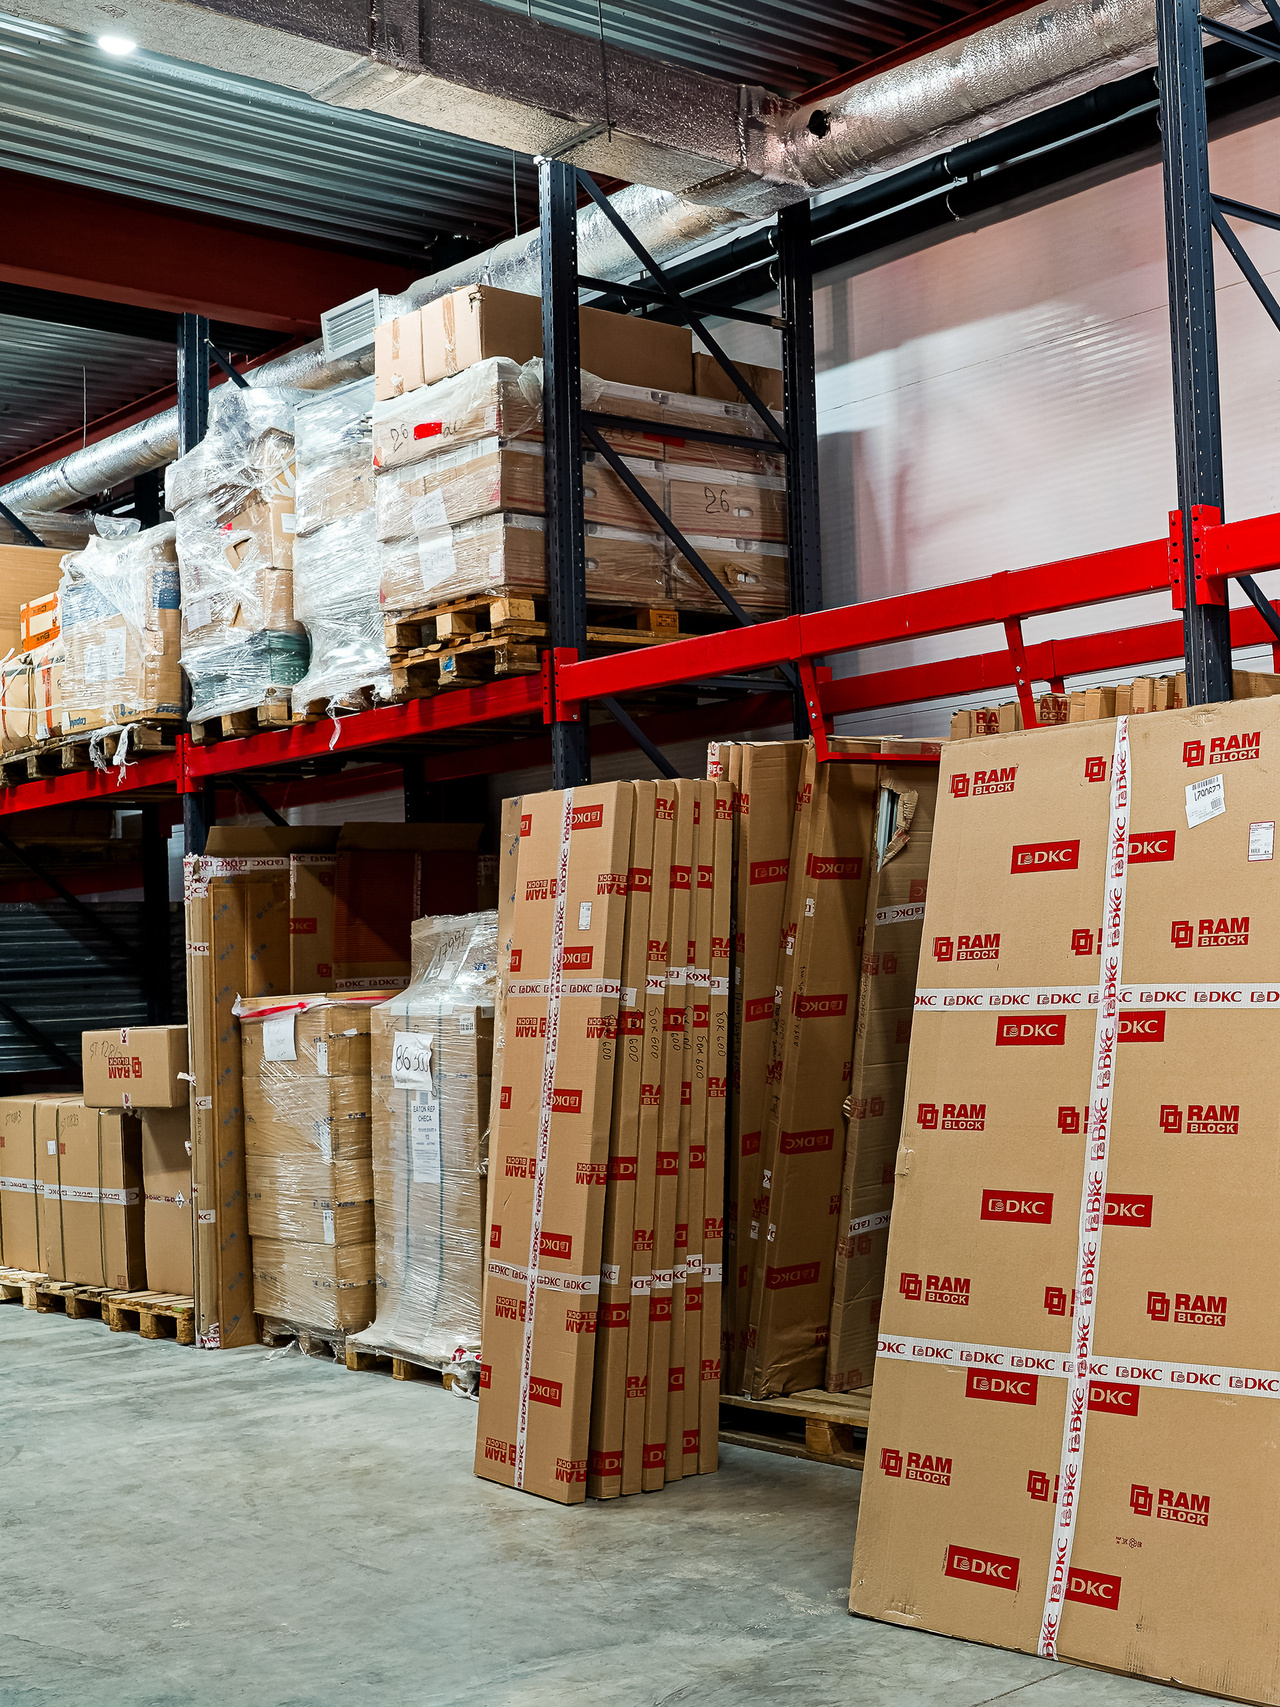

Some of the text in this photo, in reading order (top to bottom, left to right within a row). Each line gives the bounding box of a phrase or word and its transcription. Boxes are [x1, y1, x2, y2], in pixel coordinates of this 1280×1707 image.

[704, 485, 730, 514] 26
[1209, 732, 1261, 752] RAM
[1210, 749, 1258, 763] BLOCK
[973, 767, 1016, 784] RAM
[975, 781, 1015, 795] BLOCK
[1129, 838, 1168, 855] DKC
[1035, 848, 1073, 865] DKC
[816, 863, 844, 873] DKC
[526, 890, 547, 901] RAM
[1199, 917, 1250, 935] RAM
[958, 934, 1000, 950] RAM
[1200, 934, 1248, 946] BLOCK
[958, 949, 999, 960] BLOCK
[345, 979, 365, 987] DKC
[526, 985, 540, 993] DKC
[956, 995, 983, 1006] DKC
[1002, 993, 1030, 1005] DKC
[1049, 992, 1082, 1004] DKC
[1153, 990, 1186, 1003] DKC
[1206, 990, 1242, 1003] DKC
[516, 1027, 536, 1037] RAM
[1020, 1022, 1058, 1038] DKC
[1119, 1019, 1158, 1035] DKC
[628, 1039, 639, 1062] 600
[671, 1033, 681, 1051] 600
[717, 1036, 726, 1057] 600
[603, 1042, 612, 1060] 600
[109, 1067, 130, 1078] RAM
[696, 1059, 707, 1079] 600
[942, 1104, 986, 1120] RAM
[1187, 1105, 1239, 1123] RAM
[943, 1120, 984, 1130] BLOCK
[1189, 1123, 1237, 1134] BLOCK
[505, 1165, 526, 1178] RAM
[1005, 1199, 1045, 1216] DKC
[1105, 1201, 1145, 1218] DKC
[495, 1265, 591, 1290] DKC DKC DKC
[926, 1275, 970, 1293] RAM
[927, 1292, 969, 1305] BLOCK
[1175, 1294, 1227, 1314] RAM
[495, 1305, 516, 1320] RAM
[1177, 1313, 1225, 1326] BLOCK
[925, 1347, 1280, 1392] DKC DKC DKC DKC DKC DKC
[991, 1379, 1031, 1396] DKC
[1092, 1387, 1132, 1406] DKC
[485, 1446, 506, 1463] RAM
[906, 1453, 952, 1473] RAM
[907, 1470, 951, 1485] BLOCK
[1157, 1489, 1210, 1511] RAM
[1158, 1509, 1207, 1526] BLOCK
[971, 1559, 1012, 1580] DKC
[1056, 1537, 1069, 1585] DKC
[1070, 1578, 1114, 1599] DKC
